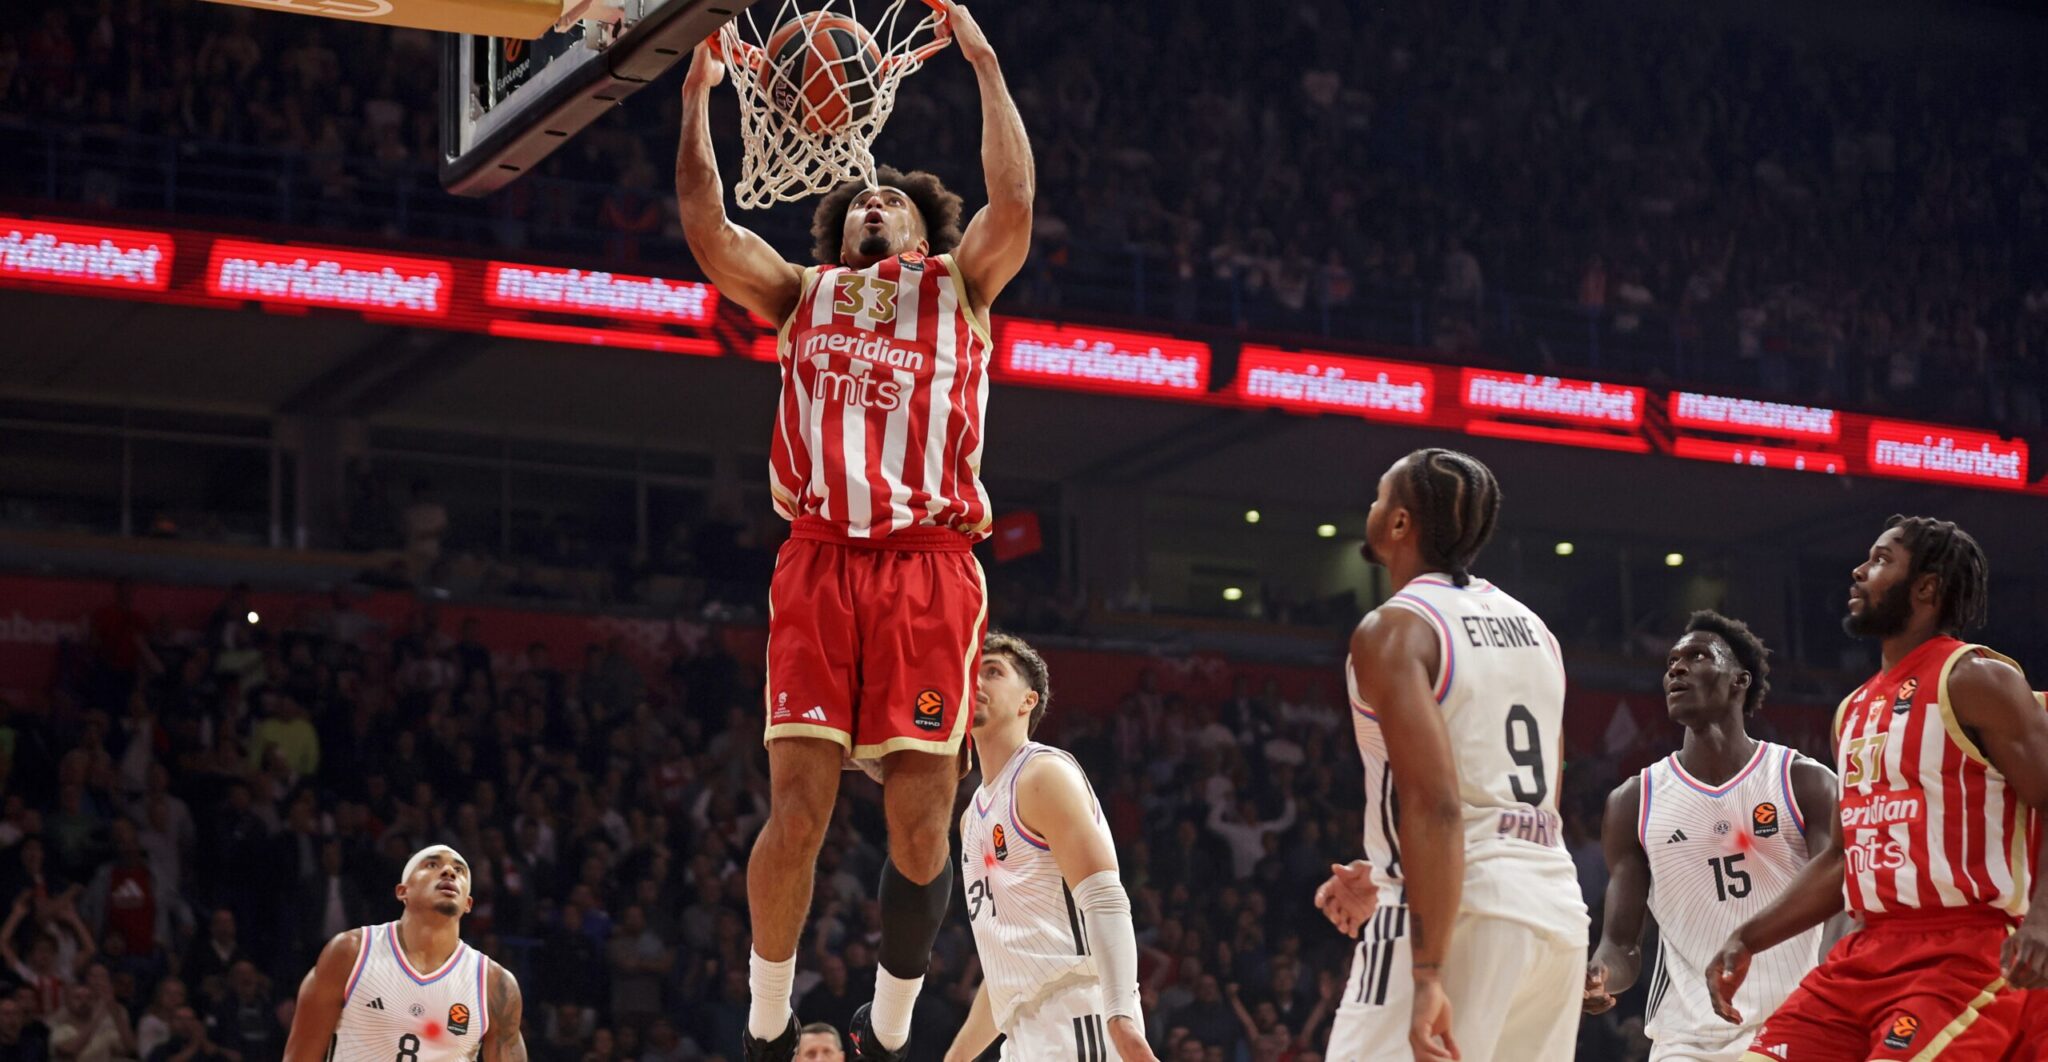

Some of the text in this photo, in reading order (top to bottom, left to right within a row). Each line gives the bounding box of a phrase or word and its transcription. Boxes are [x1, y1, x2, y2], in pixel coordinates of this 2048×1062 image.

[220, 258, 441, 312] meridianbet
[496, 268, 708, 320] meridianbet
[834, 273, 898, 324] 33
[804, 332, 923, 370] meridian
[1011, 339, 1199, 388] meridianbet
[815, 368, 902, 411] mts
[1247, 364, 1426, 413] meridianbet
[1469, 373, 1637, 422] meridianbet
[1875, 435, 2020, 480] meridianbet
[1461, 616, 1540, 648] ETIENNE
[1505, 704, 1547, 807] 9
[1845, 731, 1888, 787] 37
[968, 876, 997, 922] 34
[1708, 852, 1752, 901] 15
[396, 1032, 420, 1062] 8
